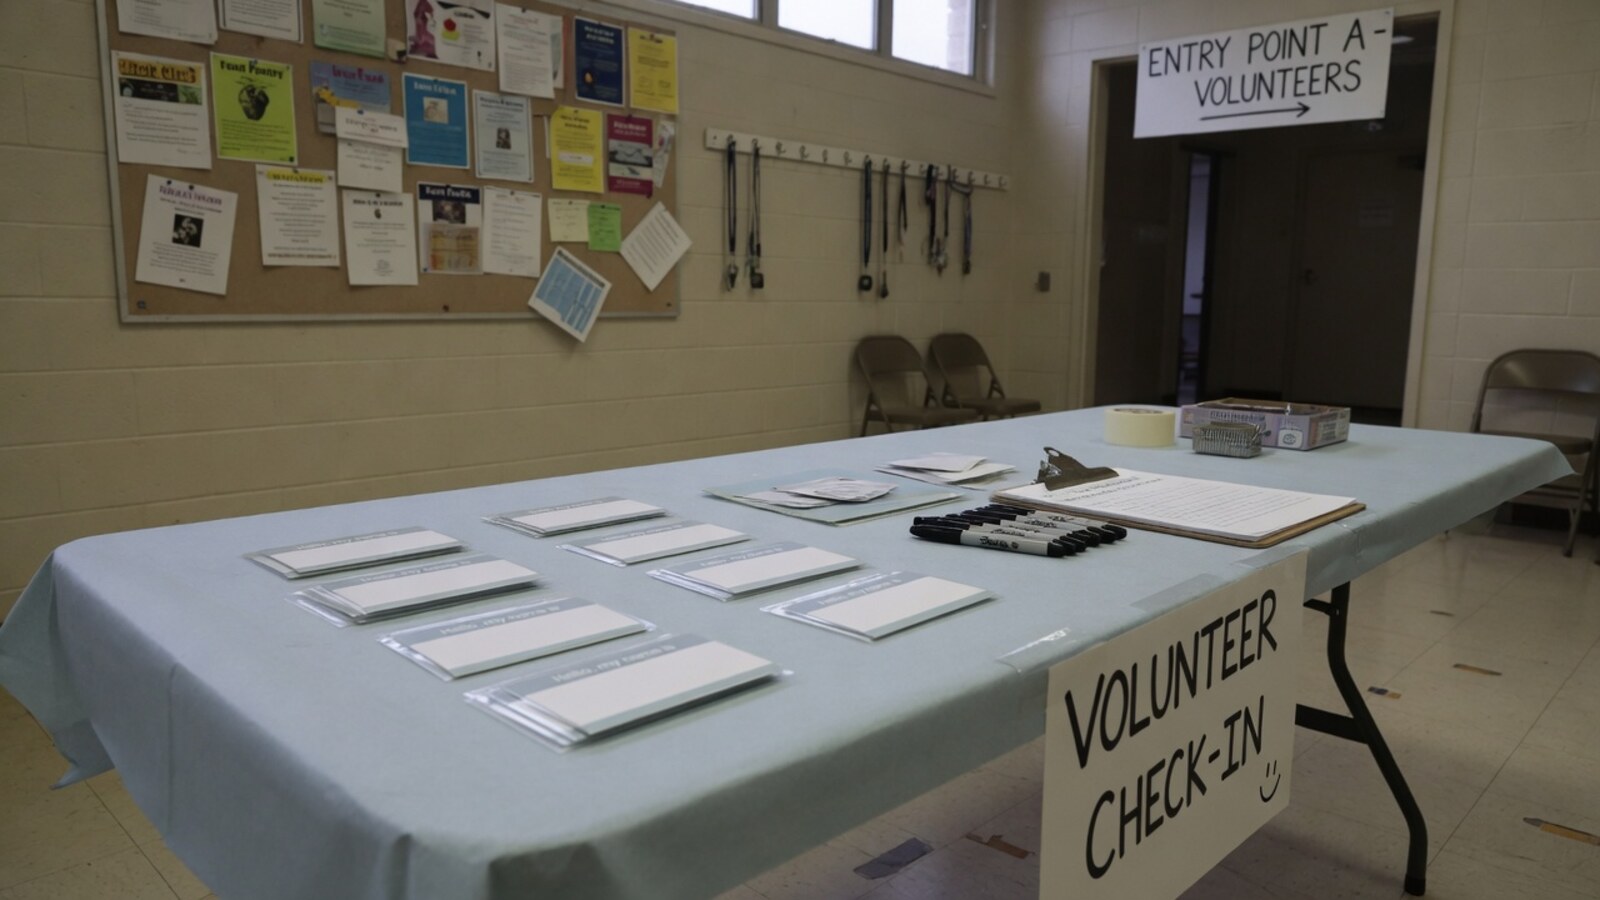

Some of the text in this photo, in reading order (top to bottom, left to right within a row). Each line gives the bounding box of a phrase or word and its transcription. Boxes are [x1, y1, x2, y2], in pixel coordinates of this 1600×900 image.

[1149, 36, 1231, 77] ENTRY
[1248, 23, 1328, 65] POINT
[1194, 59, 1362, 107] VOLUNTEERS
[1064, 588, 1278, 769] VOLUNTEER
[1085, 695, 1264, 879] CHECK-IN
